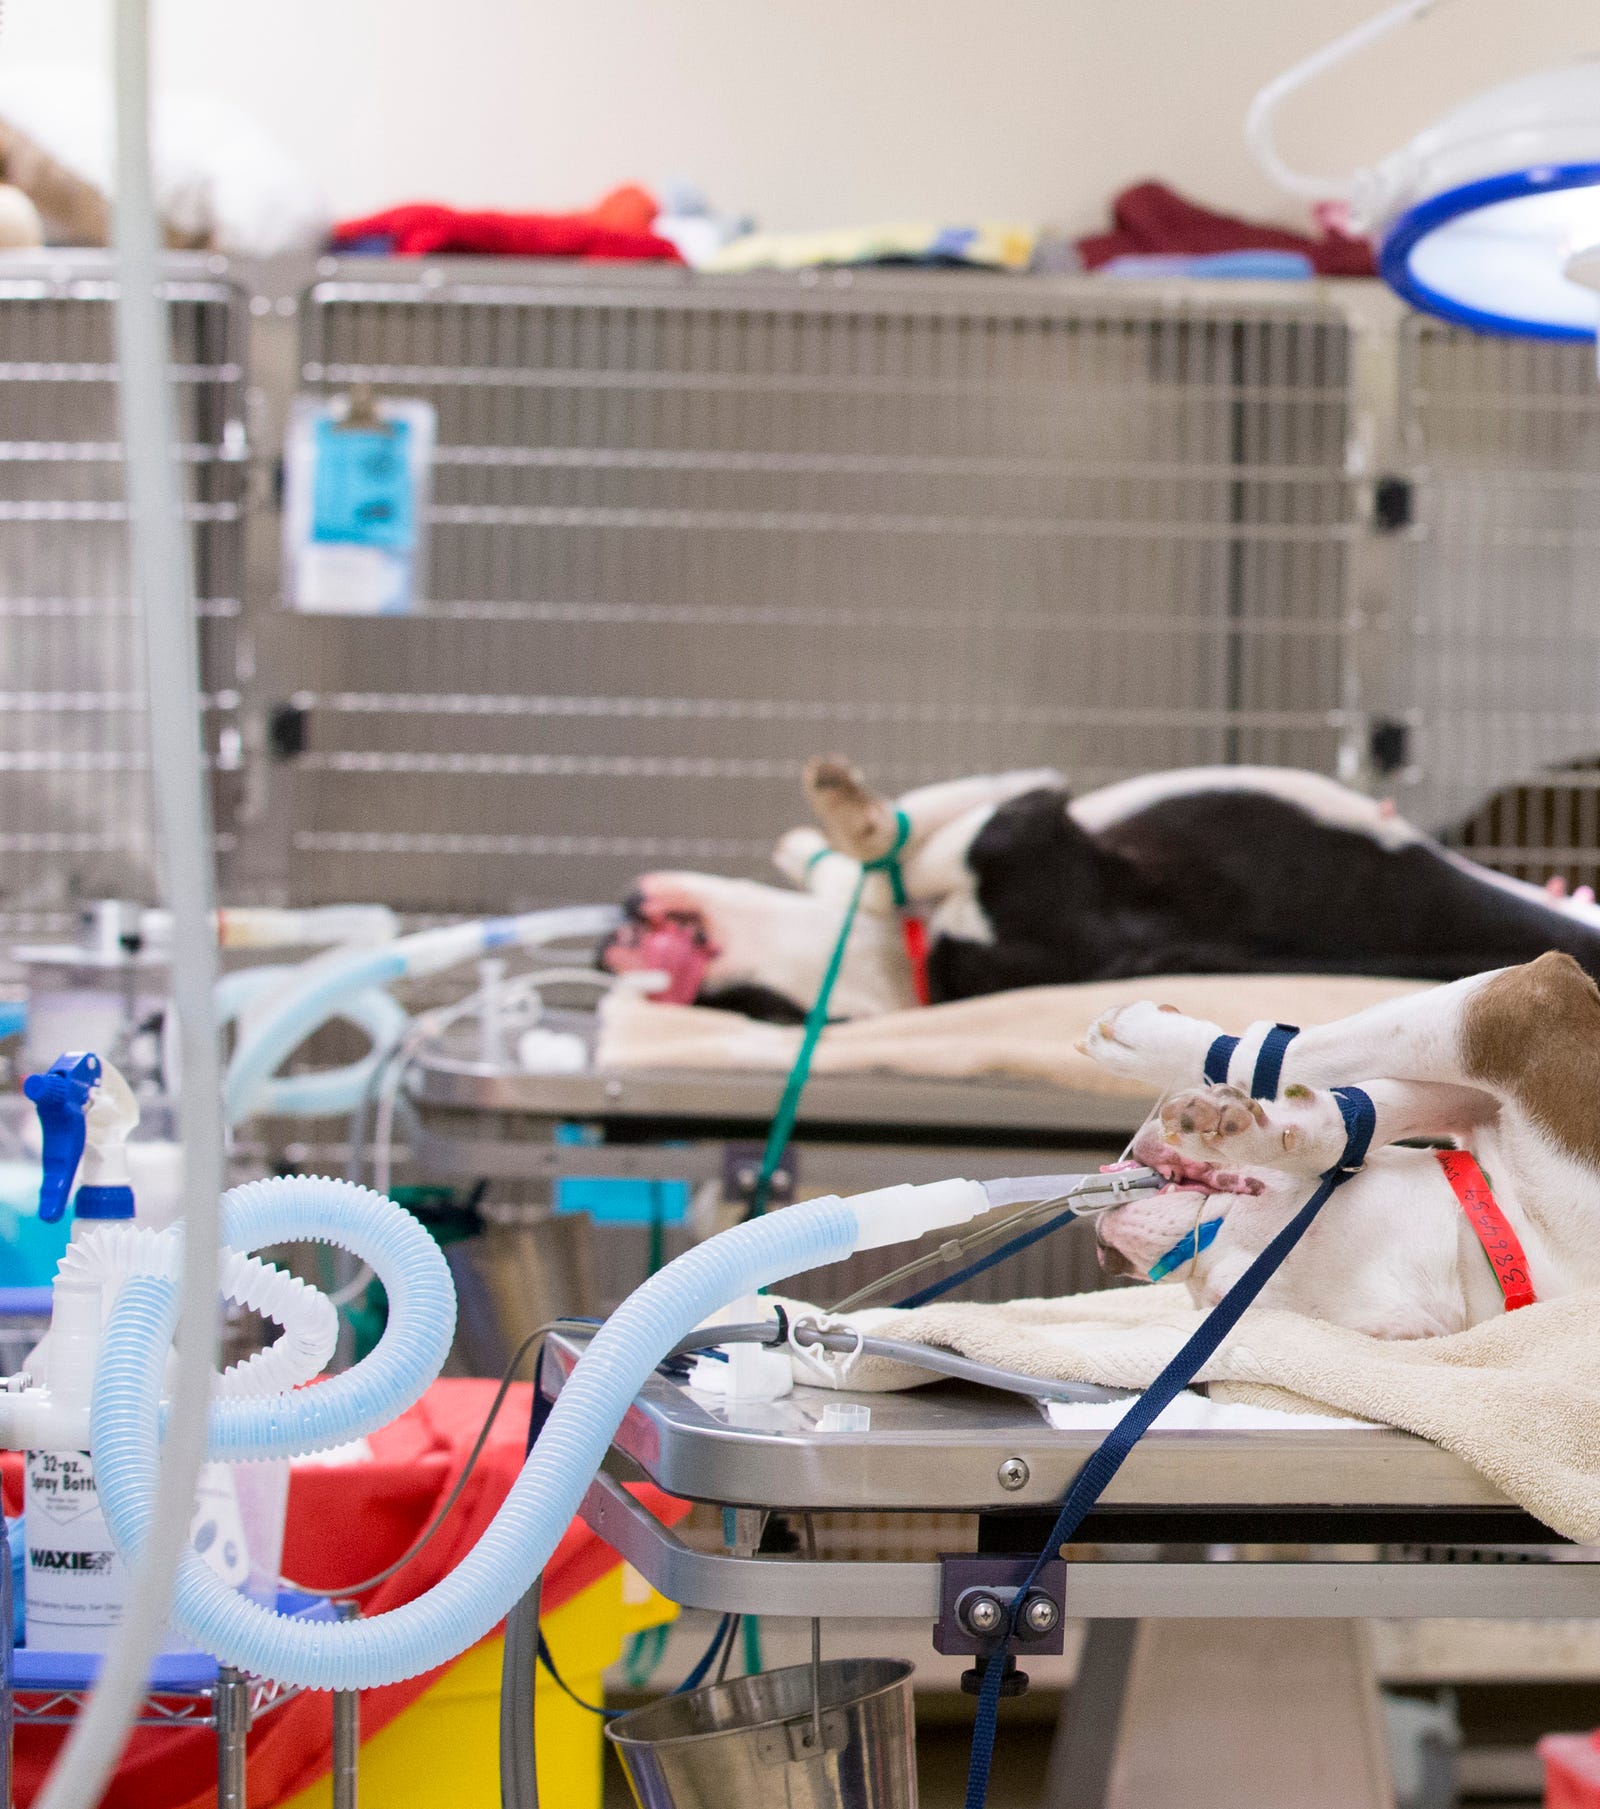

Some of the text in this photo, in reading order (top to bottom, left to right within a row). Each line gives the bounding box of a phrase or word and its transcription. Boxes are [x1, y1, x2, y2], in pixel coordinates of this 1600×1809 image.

[43, 1455, 84, 1473] 32-oz.
[31, 1471, 97, 1495] Spray Bottl
[30, 1548, 94, 1570] WAXIE
